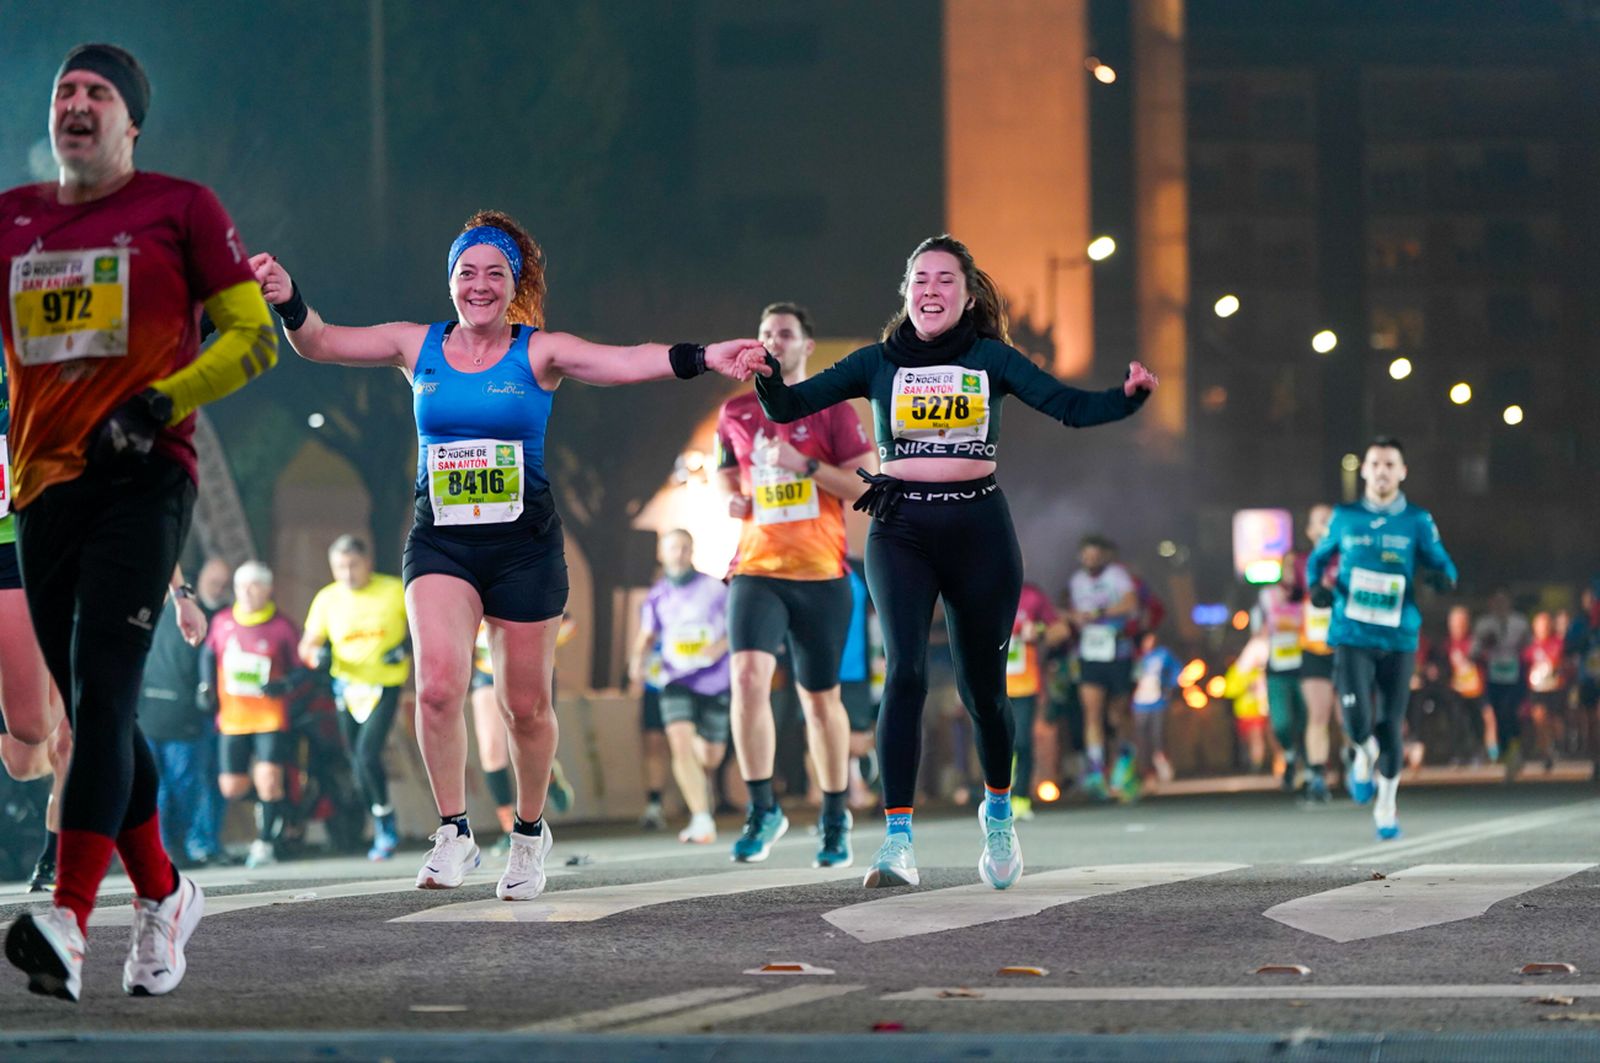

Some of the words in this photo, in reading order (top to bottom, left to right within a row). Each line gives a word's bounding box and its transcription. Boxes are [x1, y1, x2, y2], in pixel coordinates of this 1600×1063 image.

[33, 263, 68, 275] NOCHE
[22, 279, 44, 291] SAN
[42, 288, 93, 323] 972
[914, 375, 941, 384] NOCHE
[943, 374, 954, 383] DE
[903, 385, 921, 395] SAN
[911, 394, 970, 420] 5278
[447, 449, 475, 459] NOCHE
[476, 448, 487, 457] DE
[894, 441, 948, 456] NIKE
[952, 442, 997, 457] PRO
[438, 461, 456, 471] SAN
[457, 458, 488, 469] ANTÓN
[448, 469, 505, 496] 8416
[765, 482, 803, 503] 5607
